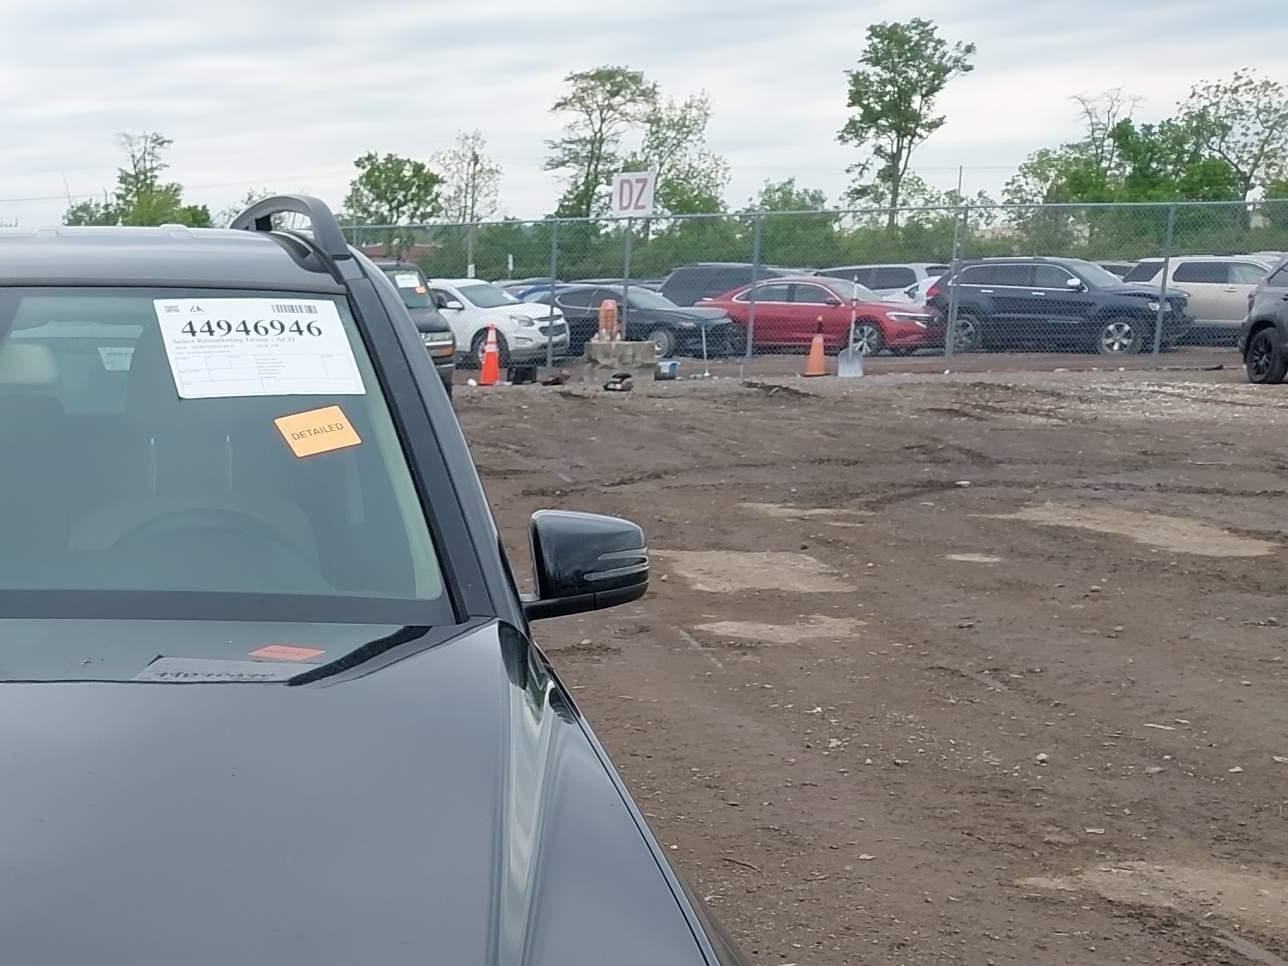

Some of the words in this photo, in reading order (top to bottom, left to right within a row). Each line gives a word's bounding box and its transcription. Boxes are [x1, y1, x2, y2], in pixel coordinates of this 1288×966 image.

[618, 177, 648, 210] DZ
[181, 319, 323, 337] 44946946
[290, 422, 344, 441] DETAILED
